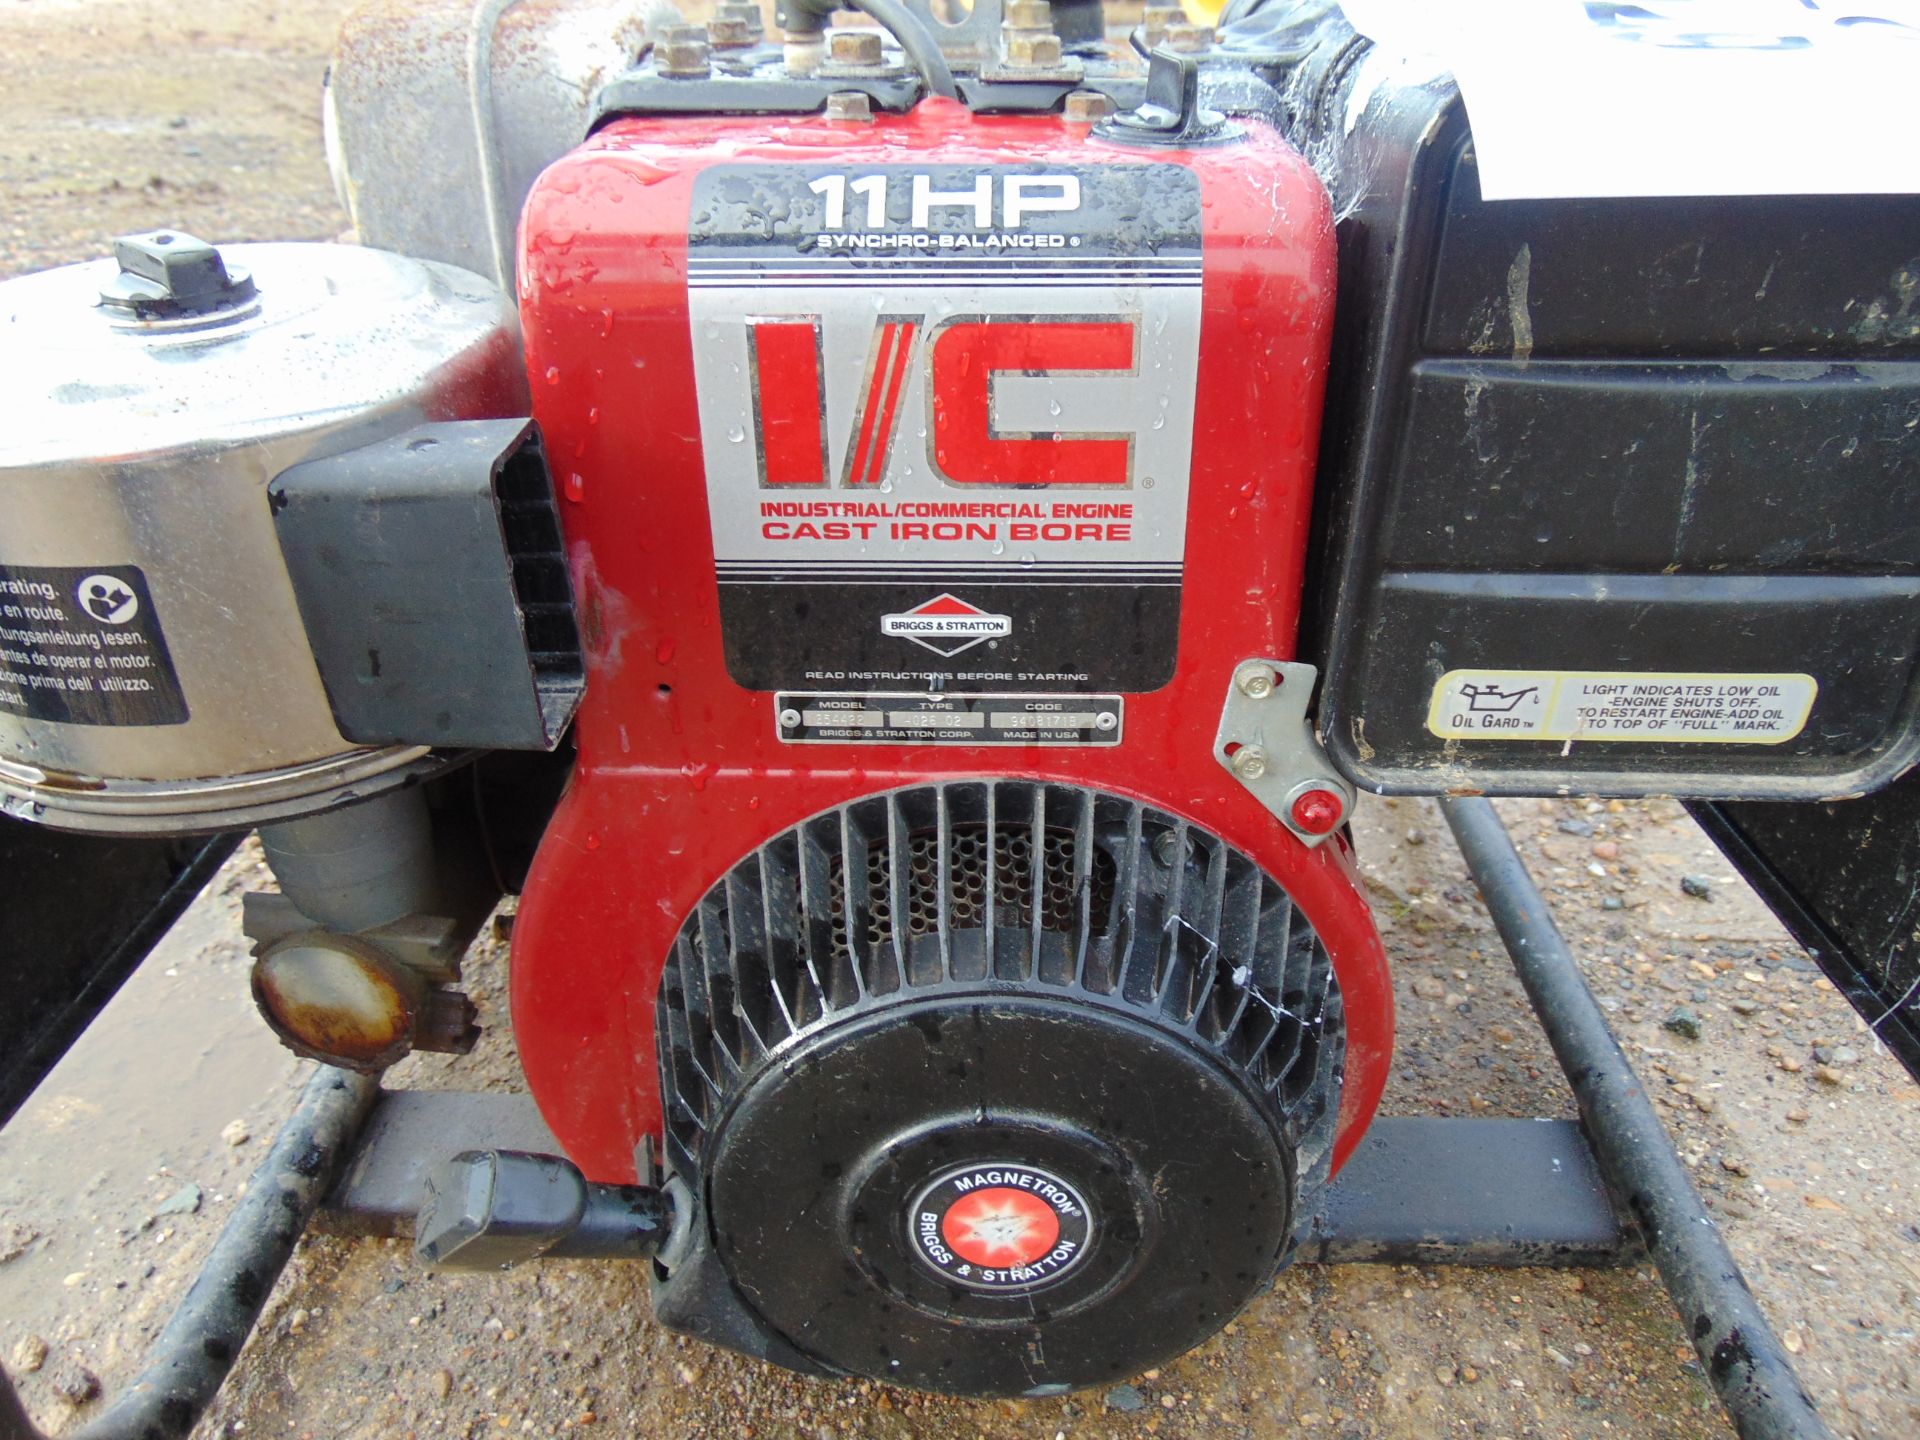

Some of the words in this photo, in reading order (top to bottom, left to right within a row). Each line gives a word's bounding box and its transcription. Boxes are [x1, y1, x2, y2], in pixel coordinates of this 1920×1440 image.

[808, 174, 887, 228] 11
[911, 174, 1081, 229] HP
[760, 502, 1046, 519] INDUSTRIAL/COMMERCIAL
[1052, 503, 1133, 519] ENGINE
[762, 522, 877, 540] CAST
[890, 522, 997, 541] IRON
[1009, 523, 1131, 541] BORE
[3, 604, 22, 618] en
[23, 605, 69, 620] route.
[890, 621, 934, 631] BRIGGS
[936, 621, 944, 631] &
[945, 621, 1004, 631] STRATTON
[101, 630, 147, 645] lesen.
[31, 651, 48, 666] de
[50, 655, 91, 671] operar
[94, 654, 108, 669] el
[109, 654, 156, 668] motor.
[28, 674, 66, 690] prima
[98, 676, 154, 691] utilizzo.
[805, 671, 845, 680] READ
[849, 671, 954, 681] INSTRUCTIONS
[956, 672, 1013, 681] BEFORE
[1017, 673, 1089, 681] STARTING
[1582, 684, 1628, 695] LIGHT
[1632, 685, 1713, 696] INDICATES
[1717, 686, 1753, 696] LOW
[1757, 686, 1781, 696] OIL
[818, 701, 867, 709] MODEL
[920, 702, 954, 710] TYPE
[1025, 703, 1063, 711] CODE
[1673, 697, 1724, 707] SHUTS
[1728, 697, 1762, 708] OFF.
[1577, 707, 1597, 718] TO
[1600, 707, 1666, 718] RESTART
[1669, 709, 1759, 719] ENGINE-ADD
[1762, 709, 1785, 719] OIL
[1452, 714, 1474, 728] OIL
[1588, 718, 1607, 729] TO
[1613, 718, 1642, 729] TOP
[1647, 719, 1668, 729] OF
[1733, 720, 1781, 730] MARK.
[818, 729, 861, 737] BRIGGS
[876, 730, 936, 738] STRATTON
[938, 731, 975, 739] CORP.
[1003, 731, 1037, 739] MADE
[1040, 731, 1052, 739] IN
[920, 1211, 954, 1265] BRIGGS
[957, 1263, 972, 1277] &
[982, 1240, 1077, 1283] STRATTON
